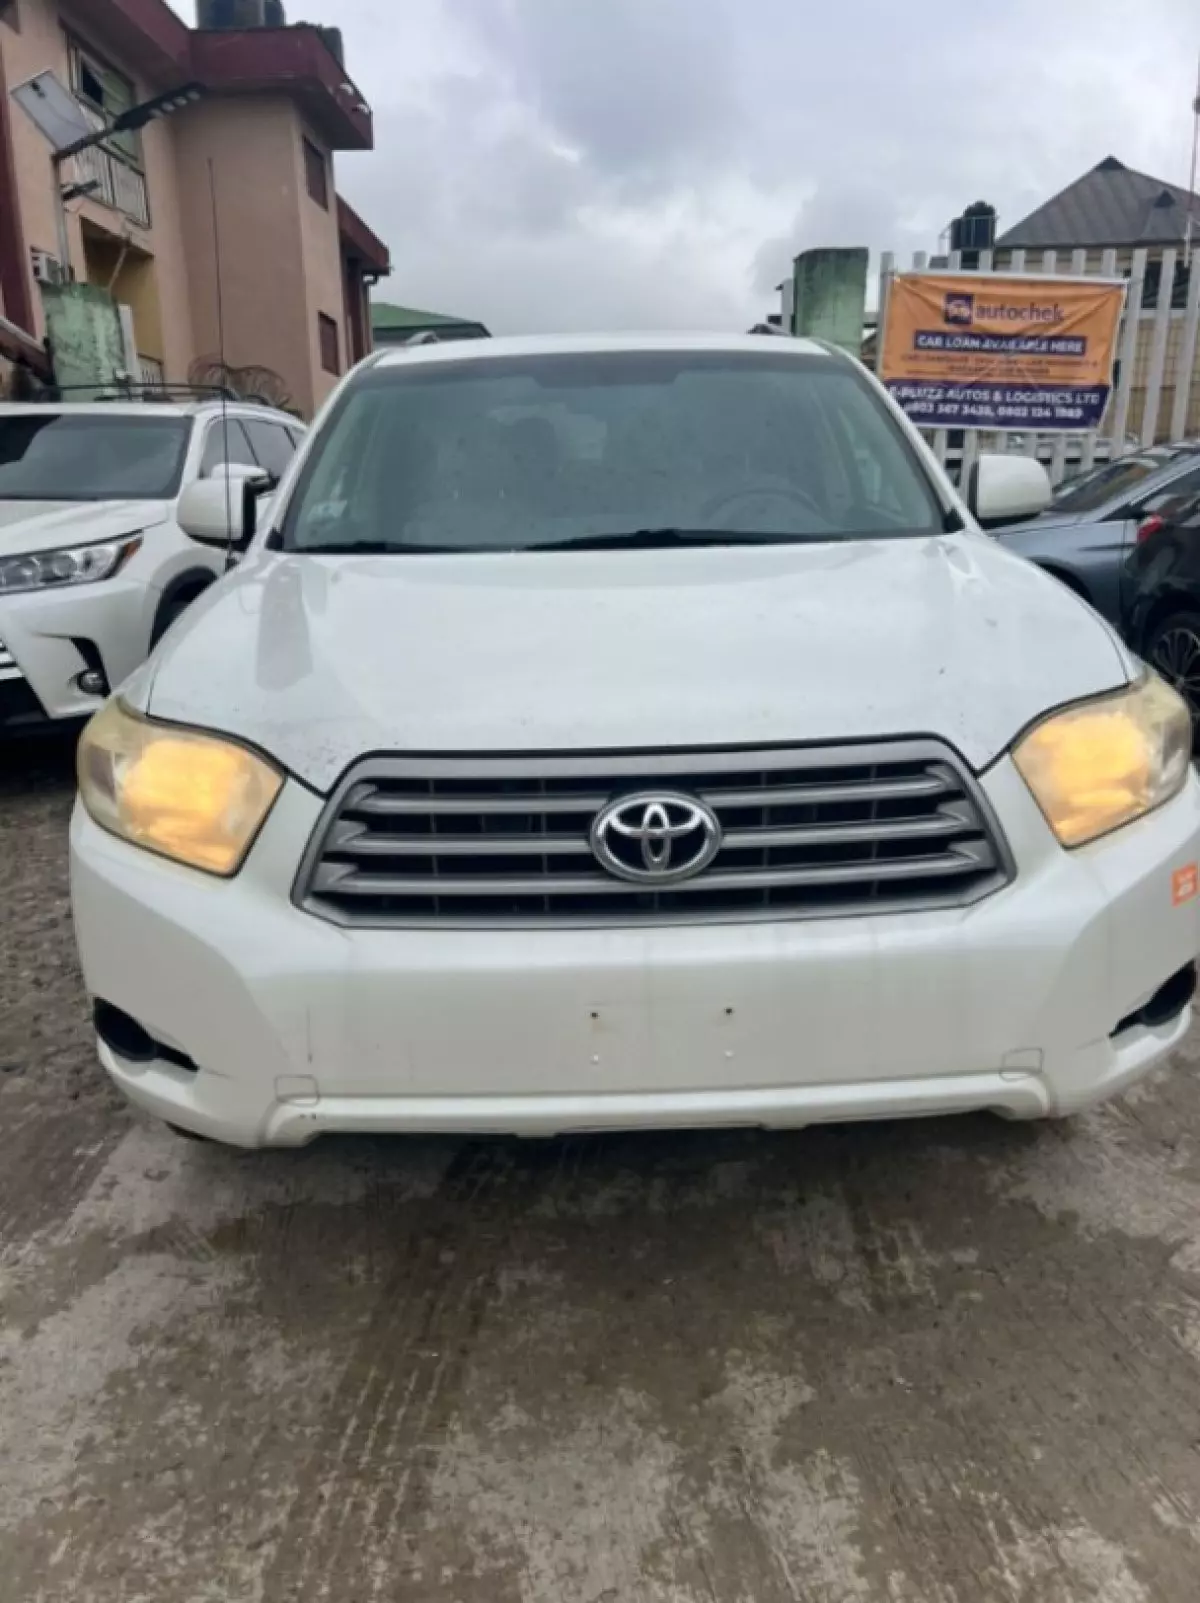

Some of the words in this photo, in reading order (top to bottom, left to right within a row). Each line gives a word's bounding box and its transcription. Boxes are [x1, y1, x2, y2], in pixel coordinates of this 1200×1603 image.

[975, 302, 1064, 323] autochek
[917, 334, 943, 349] CAR
[945, 336, 981, 350] LOAN
[1051, 339, 1084, 353] HERE
[946, 388, 990, 402] AUTOS
[1005, 390, 1073, 404] LOGISTICS
